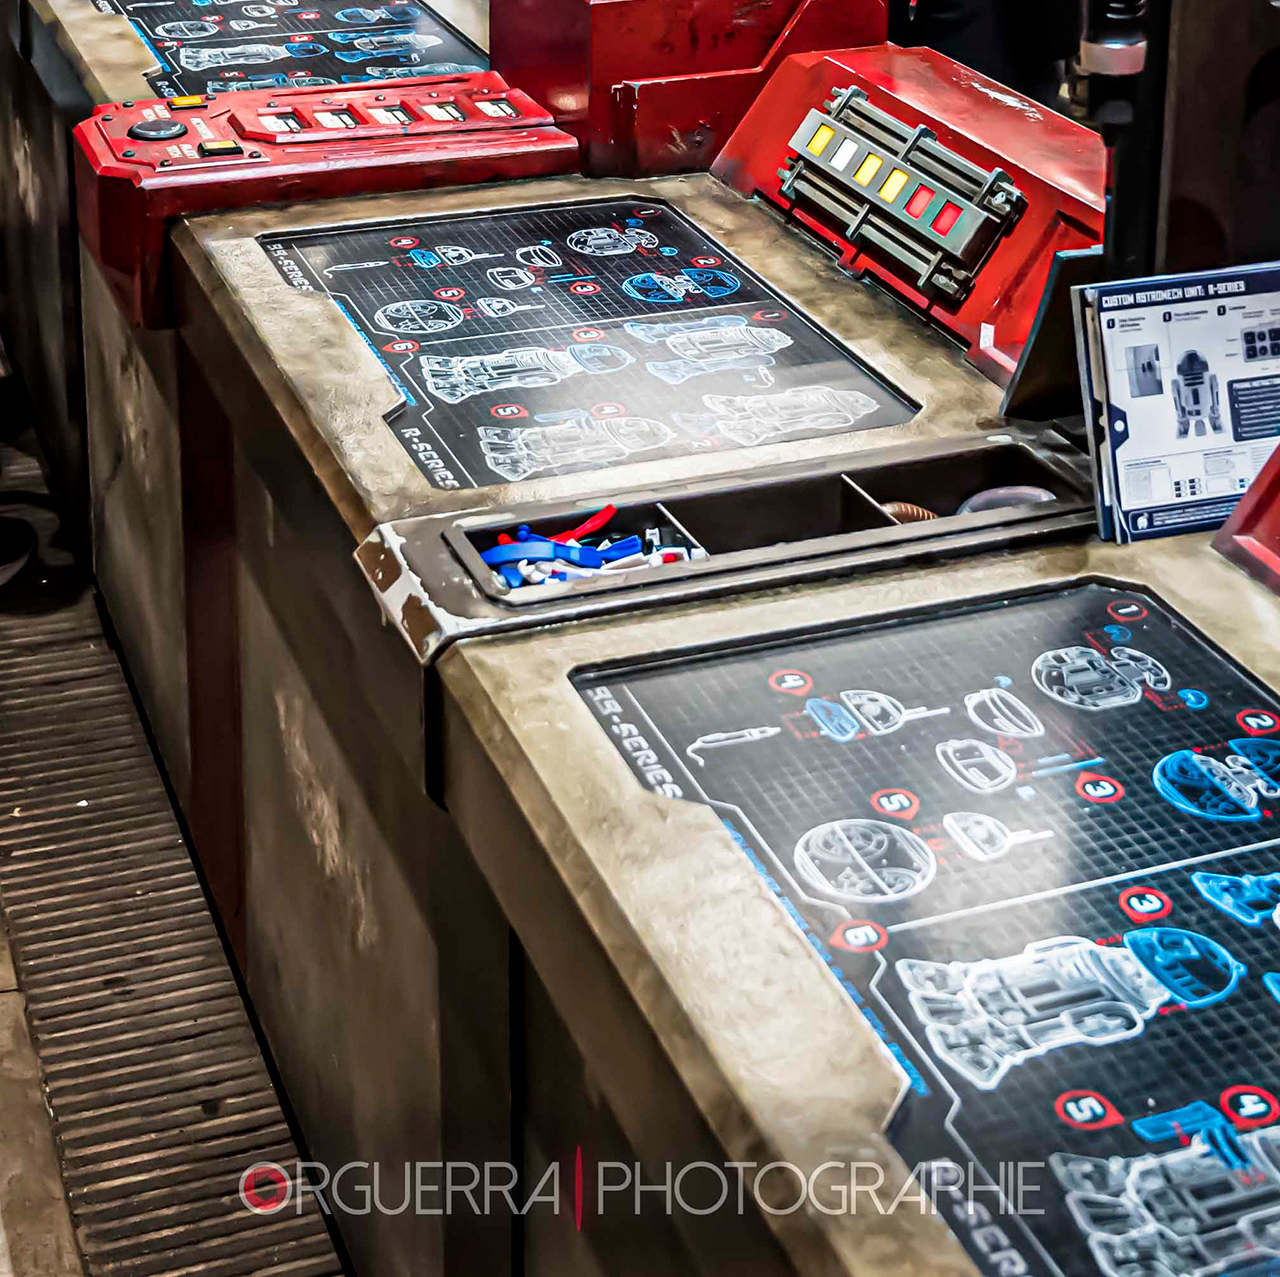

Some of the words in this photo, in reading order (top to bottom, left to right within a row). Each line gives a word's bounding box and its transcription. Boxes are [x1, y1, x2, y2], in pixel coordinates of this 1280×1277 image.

[1102, 293, 1134, 308] CUSTOM
[1135, 287, 1183, 303] ASTROMECH
[497, 405, 519, 416] 5
[401, 426, 462, 491] R-SERIES
[781, 674, 806, 690] 4
[1245, 713, 1275, 730] 2
[1084, 780, 1116, 798] 3
[879, 792, 912, 812] 5
[1129, 893, 1163, 915] 3
[844, 924, 880, 947] 6
[1065, 1095, 1107, 1123] 5
[1238, 1093, 1270, 1117] 4
